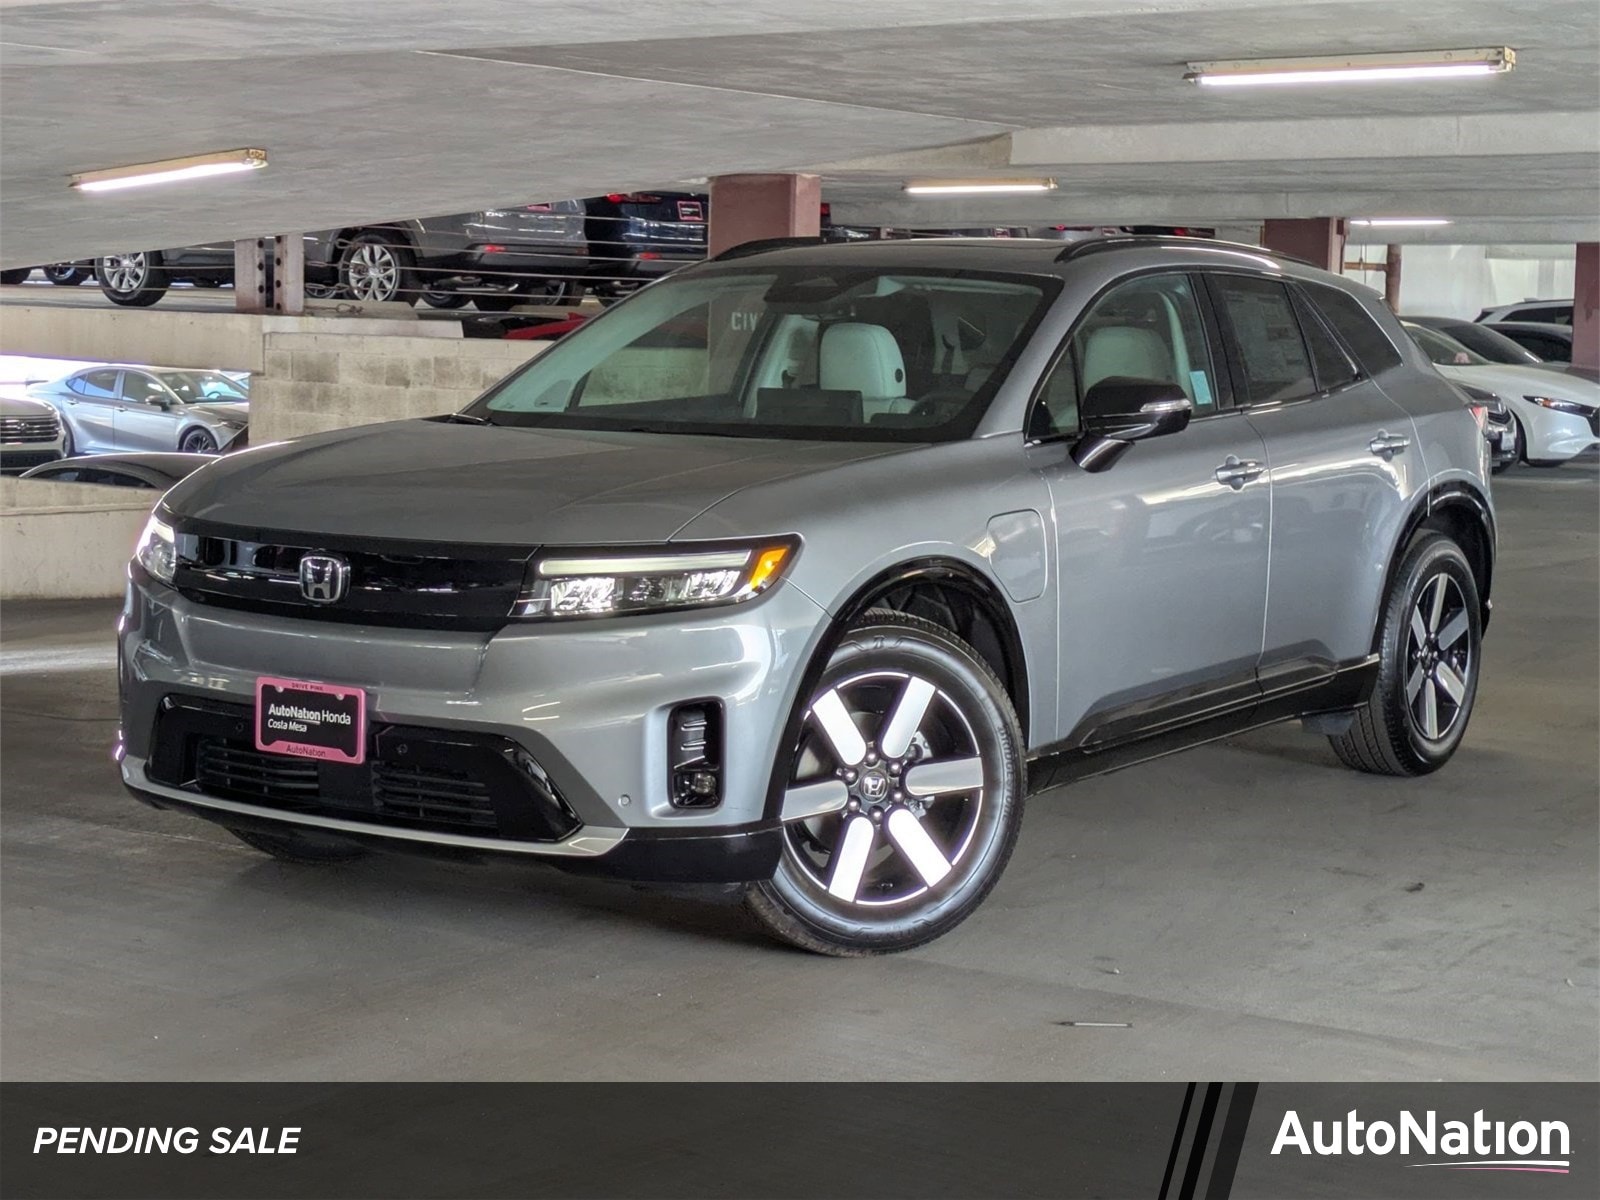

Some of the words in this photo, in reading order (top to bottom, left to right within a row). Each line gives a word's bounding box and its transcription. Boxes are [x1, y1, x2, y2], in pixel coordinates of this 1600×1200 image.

[731, 311, 764, 331] CIV
[291, 682, 309, 690] DRIVE
[268, 703, 321, 720] AutoNation
[321, 710, 351, 725] Honda
[267, 718, 288, 730] Costa
[288, 721, 307, 732] Mesa
[286, 745, 326, 757] AutoNation
